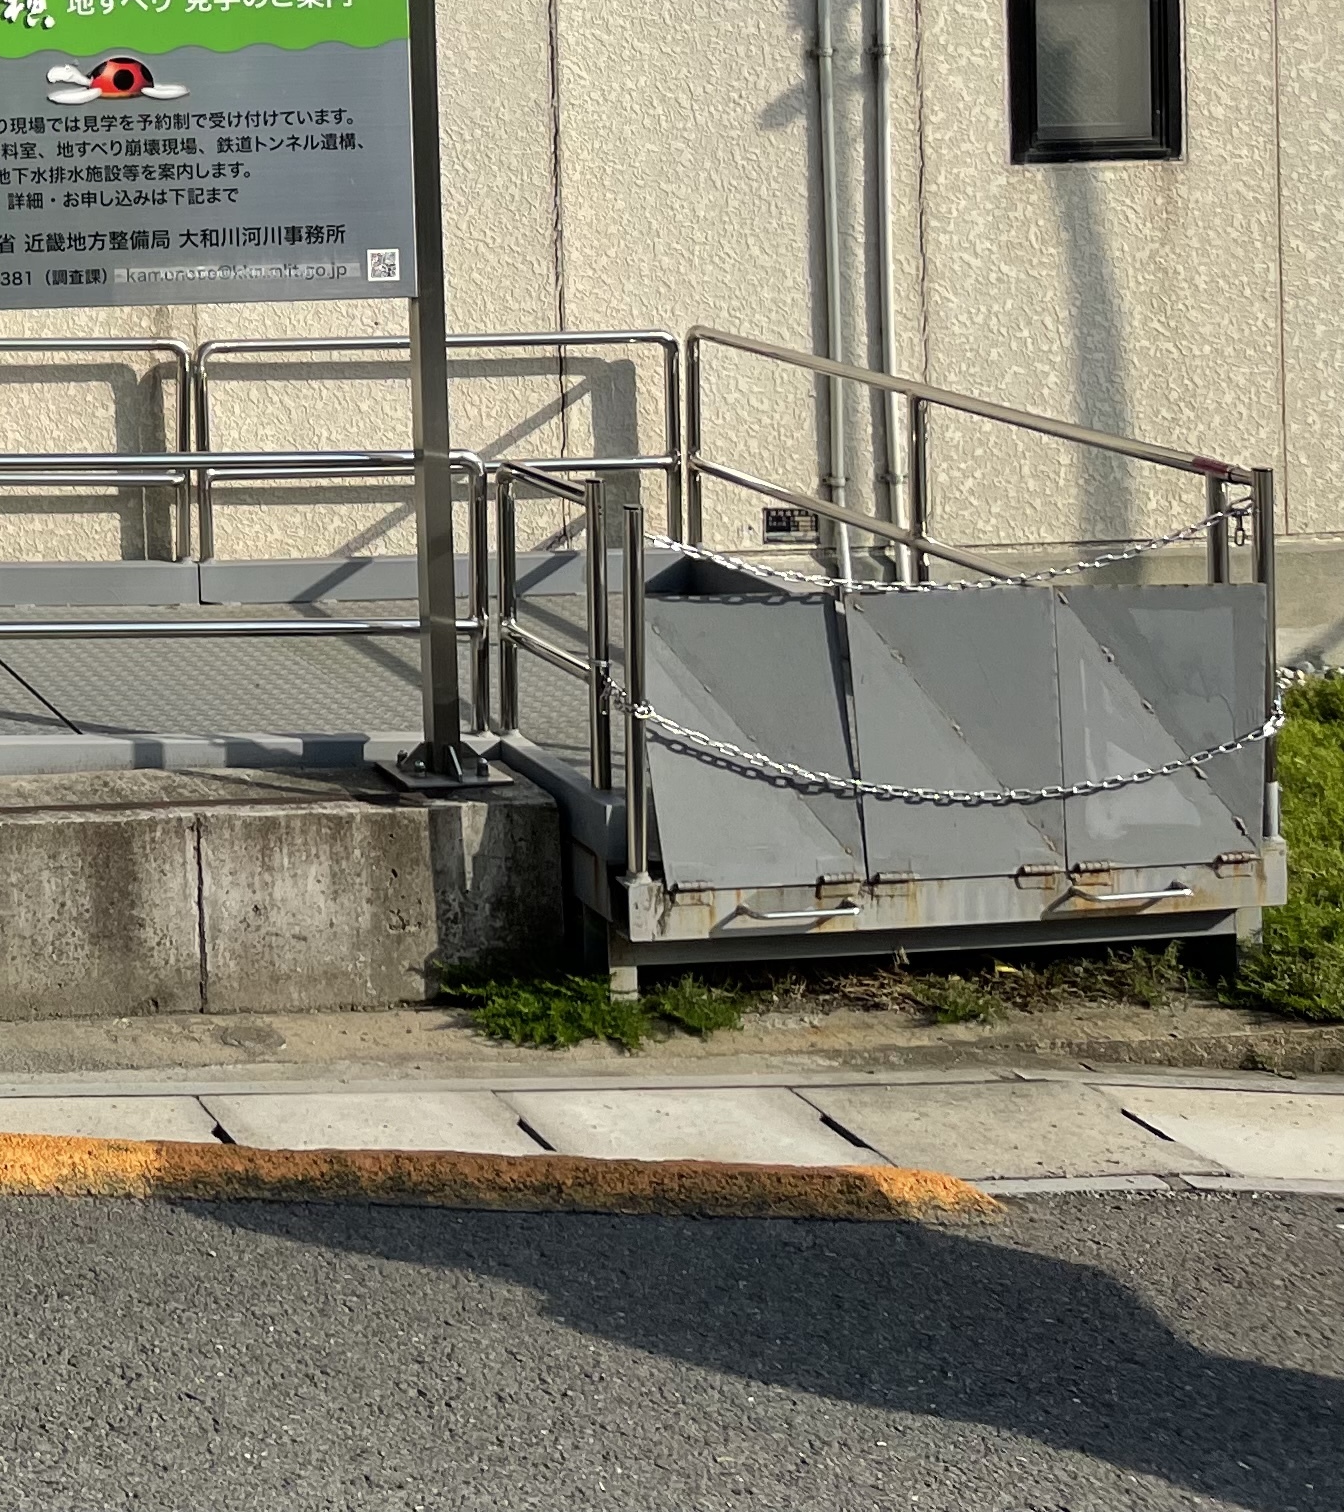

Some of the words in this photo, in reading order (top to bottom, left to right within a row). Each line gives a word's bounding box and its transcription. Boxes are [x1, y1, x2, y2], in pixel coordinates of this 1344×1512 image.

[7, 187, 239, 210] 詳細・お申し込みは下記まで
[24, 229, 170, 254] 近畿地方整備局
[178, 223, 346, 249] 大和川河川事務所
